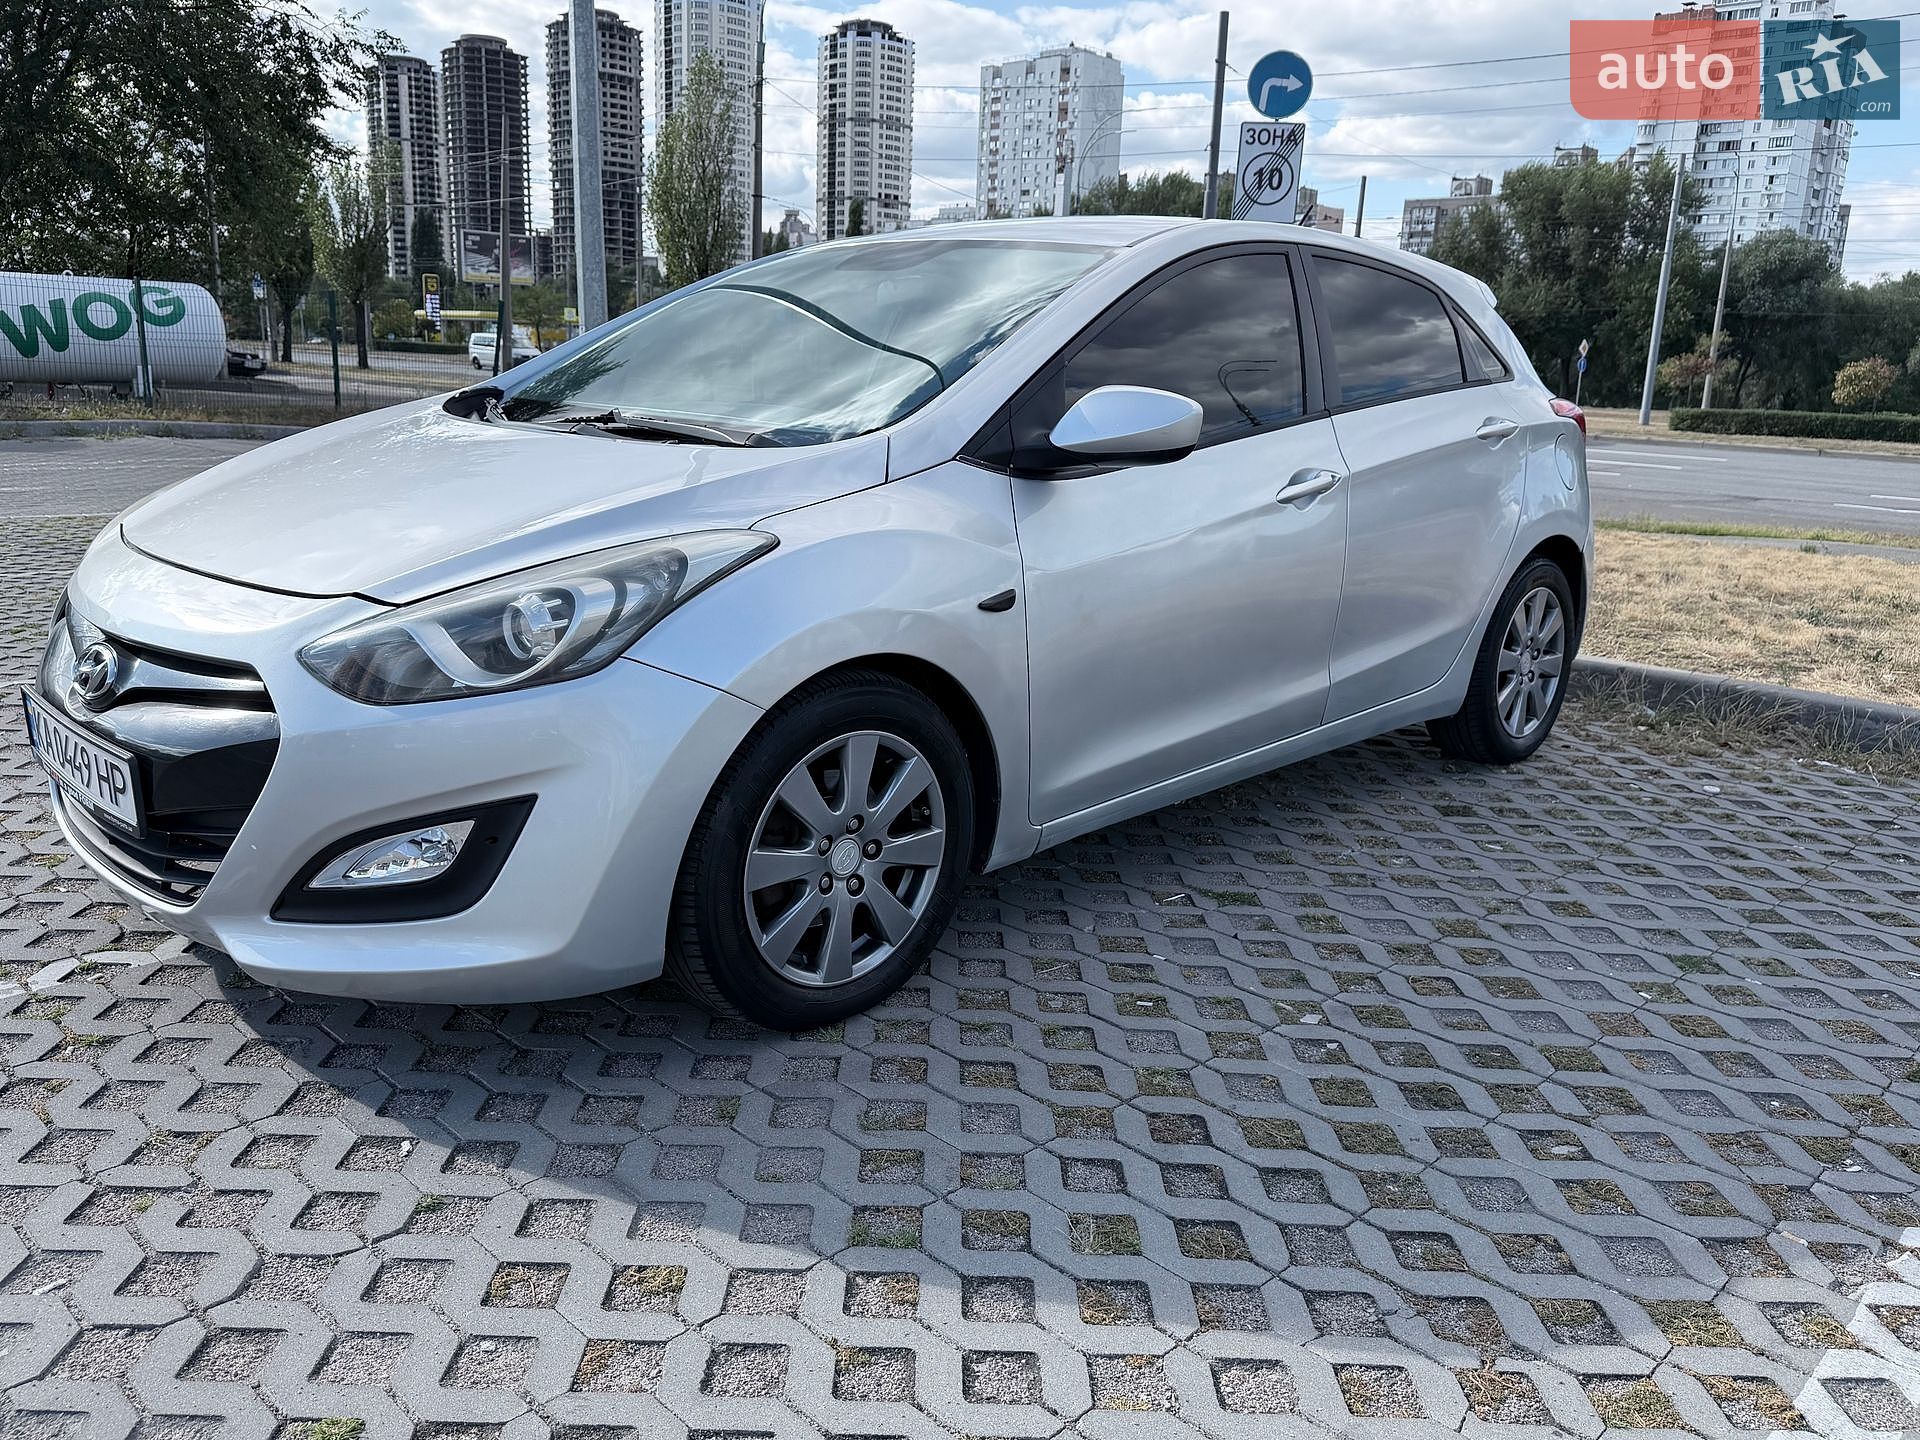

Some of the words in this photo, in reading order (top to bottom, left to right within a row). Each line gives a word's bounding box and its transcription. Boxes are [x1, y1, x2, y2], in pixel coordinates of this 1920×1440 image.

[1245, 128, 1299, 146] ЗОНА
[1253, 167, 1283, 191] 10
[0, 286, 186, 359] WOG
